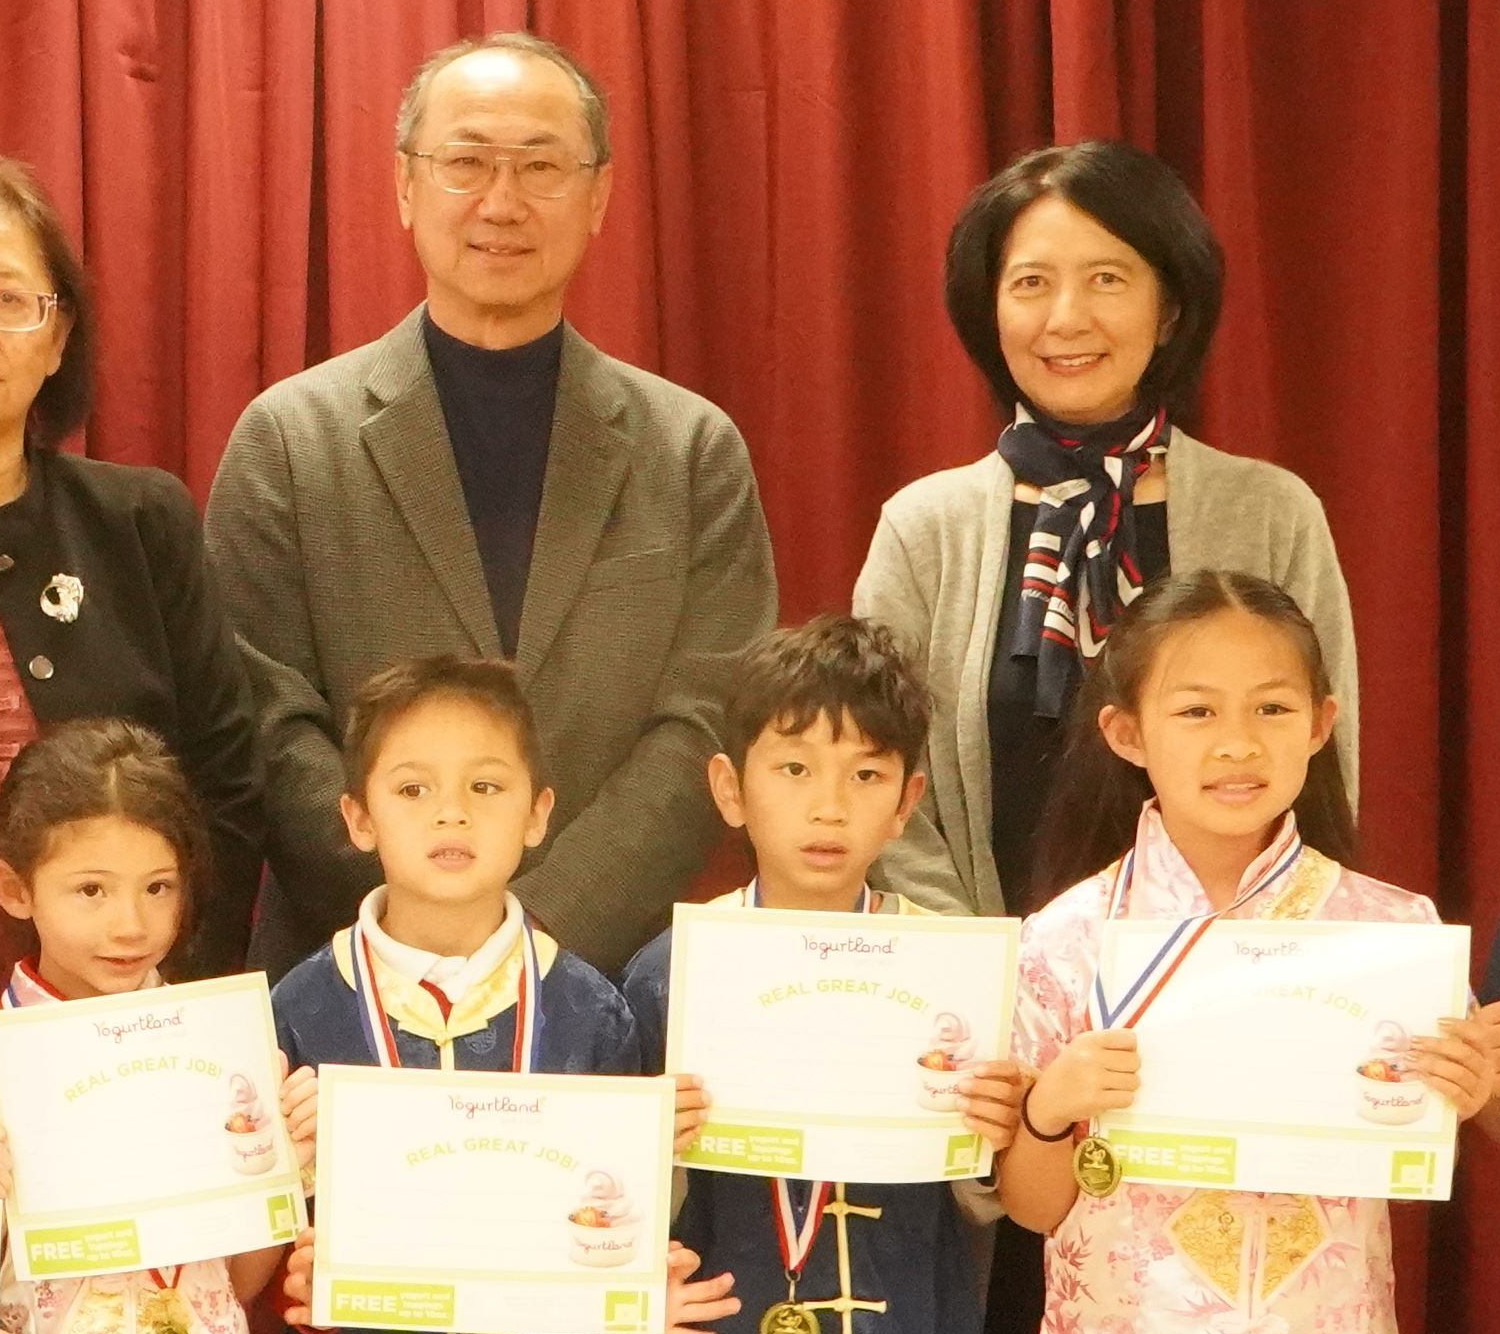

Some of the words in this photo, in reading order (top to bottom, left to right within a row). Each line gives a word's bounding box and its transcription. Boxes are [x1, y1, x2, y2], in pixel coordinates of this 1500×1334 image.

[802, 934, 896, 961] Yogurtland
[758, 982, 812, 1009] REAL
[816, 979, 882, 997] GREAT
[886, 986, 931, 1014] JOB!
[1322, 991, 1369, 1021] JOB!
[93, 1013, 184, 1045] Yogurtland
[64, 1070, 113, 1103] REAL
[117, 1055, 180, 1079] GREAT
[184, 1058, 223, 1081] JOB!
[447, 1094, 542, 1120] Yogurtland
[405, 1140, 457, 1168] REAL
[463, 1137, 529, 1156] GREAT
[533, 1144, 580, 1173] JOB!
[30, 1240, 85, 1264] FREE
[335, 1292, 398, 1314] FREE
